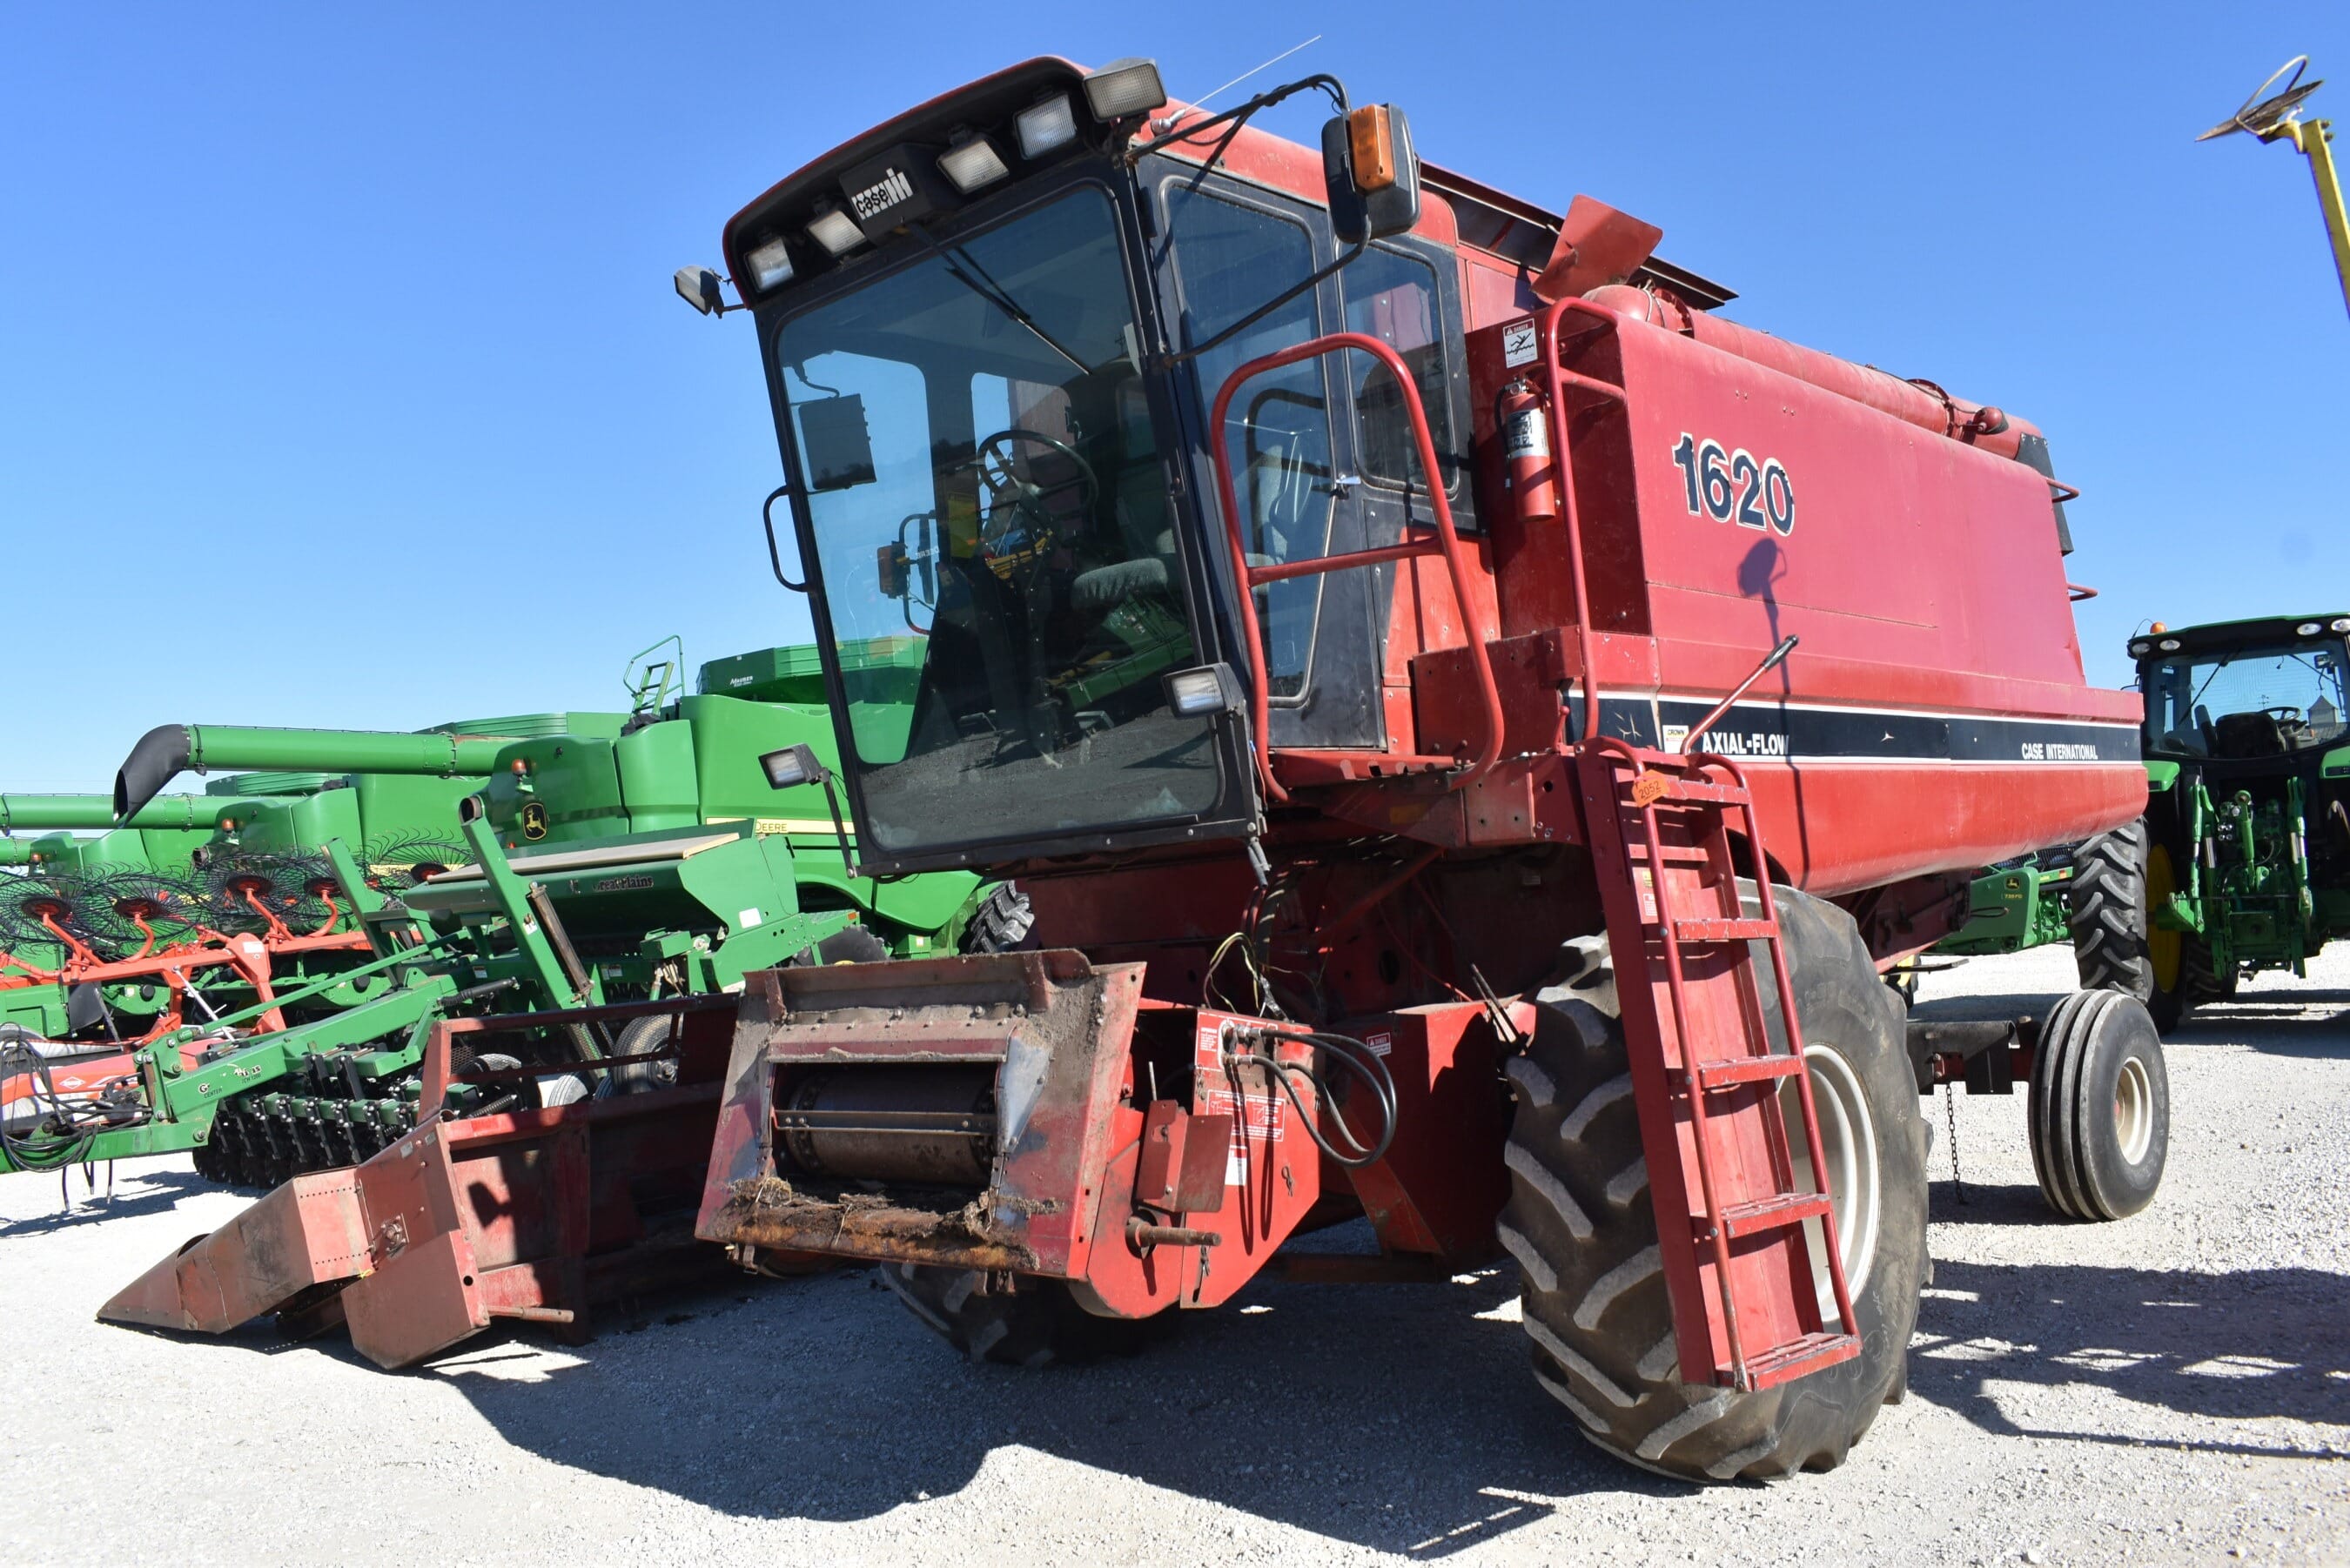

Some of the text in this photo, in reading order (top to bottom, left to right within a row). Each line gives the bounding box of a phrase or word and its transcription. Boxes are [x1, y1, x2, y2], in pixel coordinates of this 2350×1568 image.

[1671, 432, 1795, 537] 1620
[1702, 731, 1789, 755] AXIAL-FLOW
[2021, 742, 2098, 760] CASE INTERNATIONAL
[1639, 781, 1662, 799] 2052
